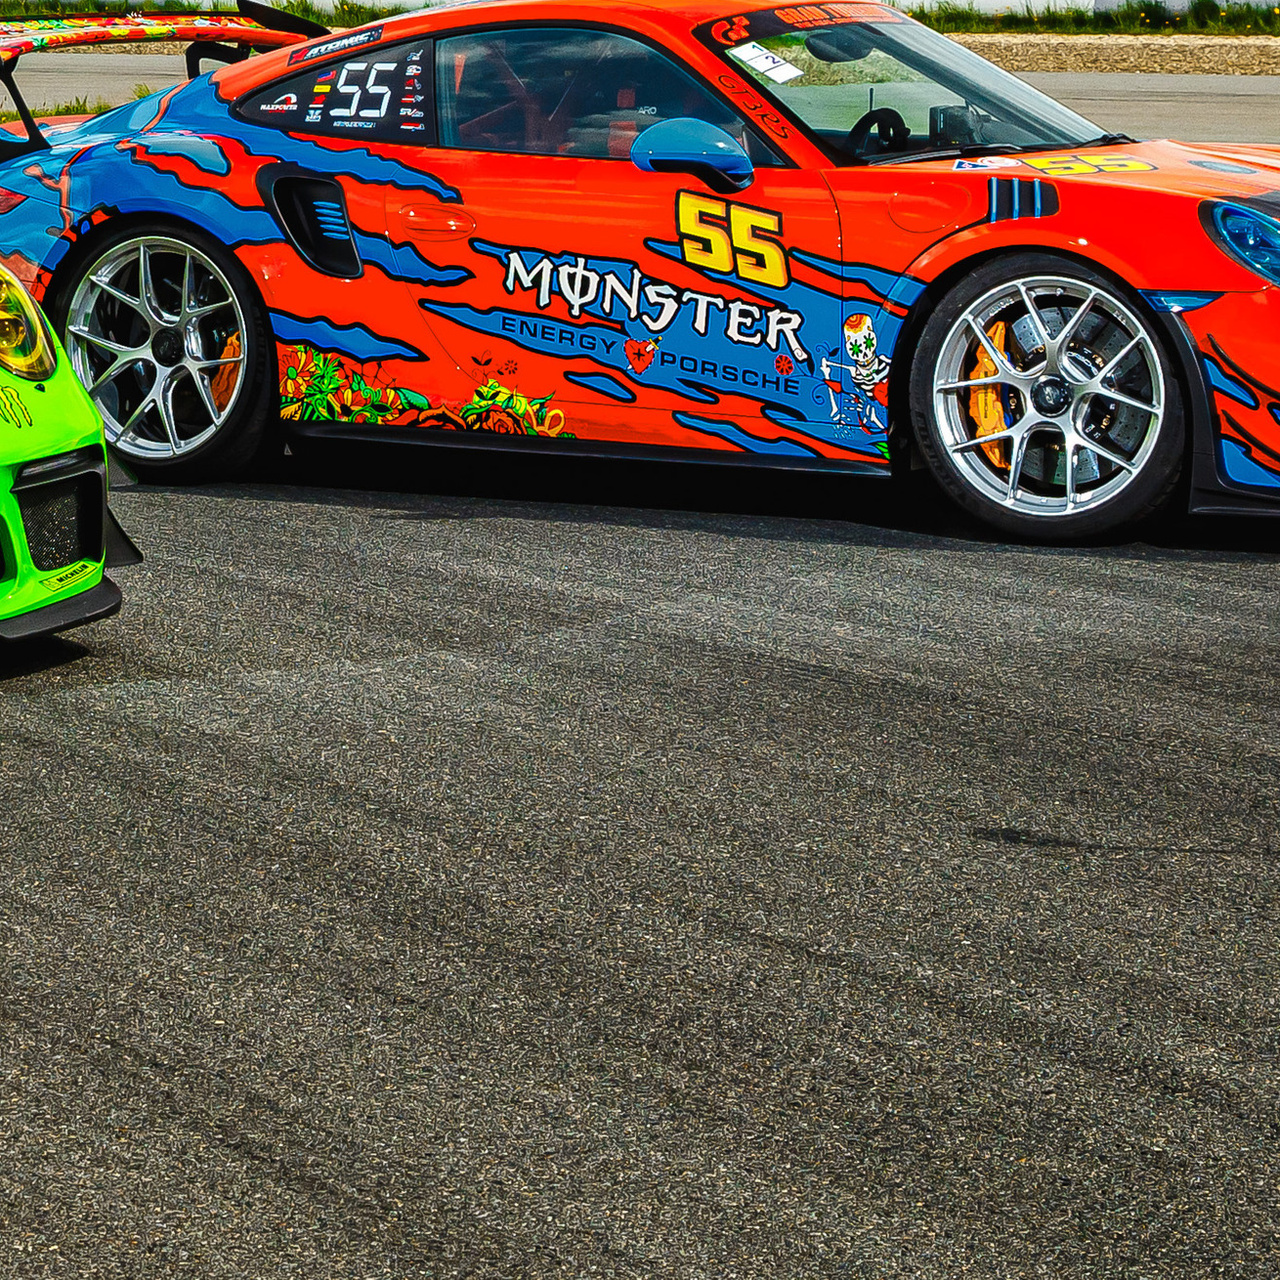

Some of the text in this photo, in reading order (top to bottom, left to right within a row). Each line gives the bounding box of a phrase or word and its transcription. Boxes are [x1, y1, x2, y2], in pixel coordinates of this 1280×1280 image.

[329, 62, 398, 118] 55
[718, 74, 795, 140] GT3RS
[1022, 154, 1155, 176] 55
[677, 190, 789, 289] 55
[506, 251, 809, 362] MONSTER
[501, 316, 801, 396] ENERGY PORSCHE
